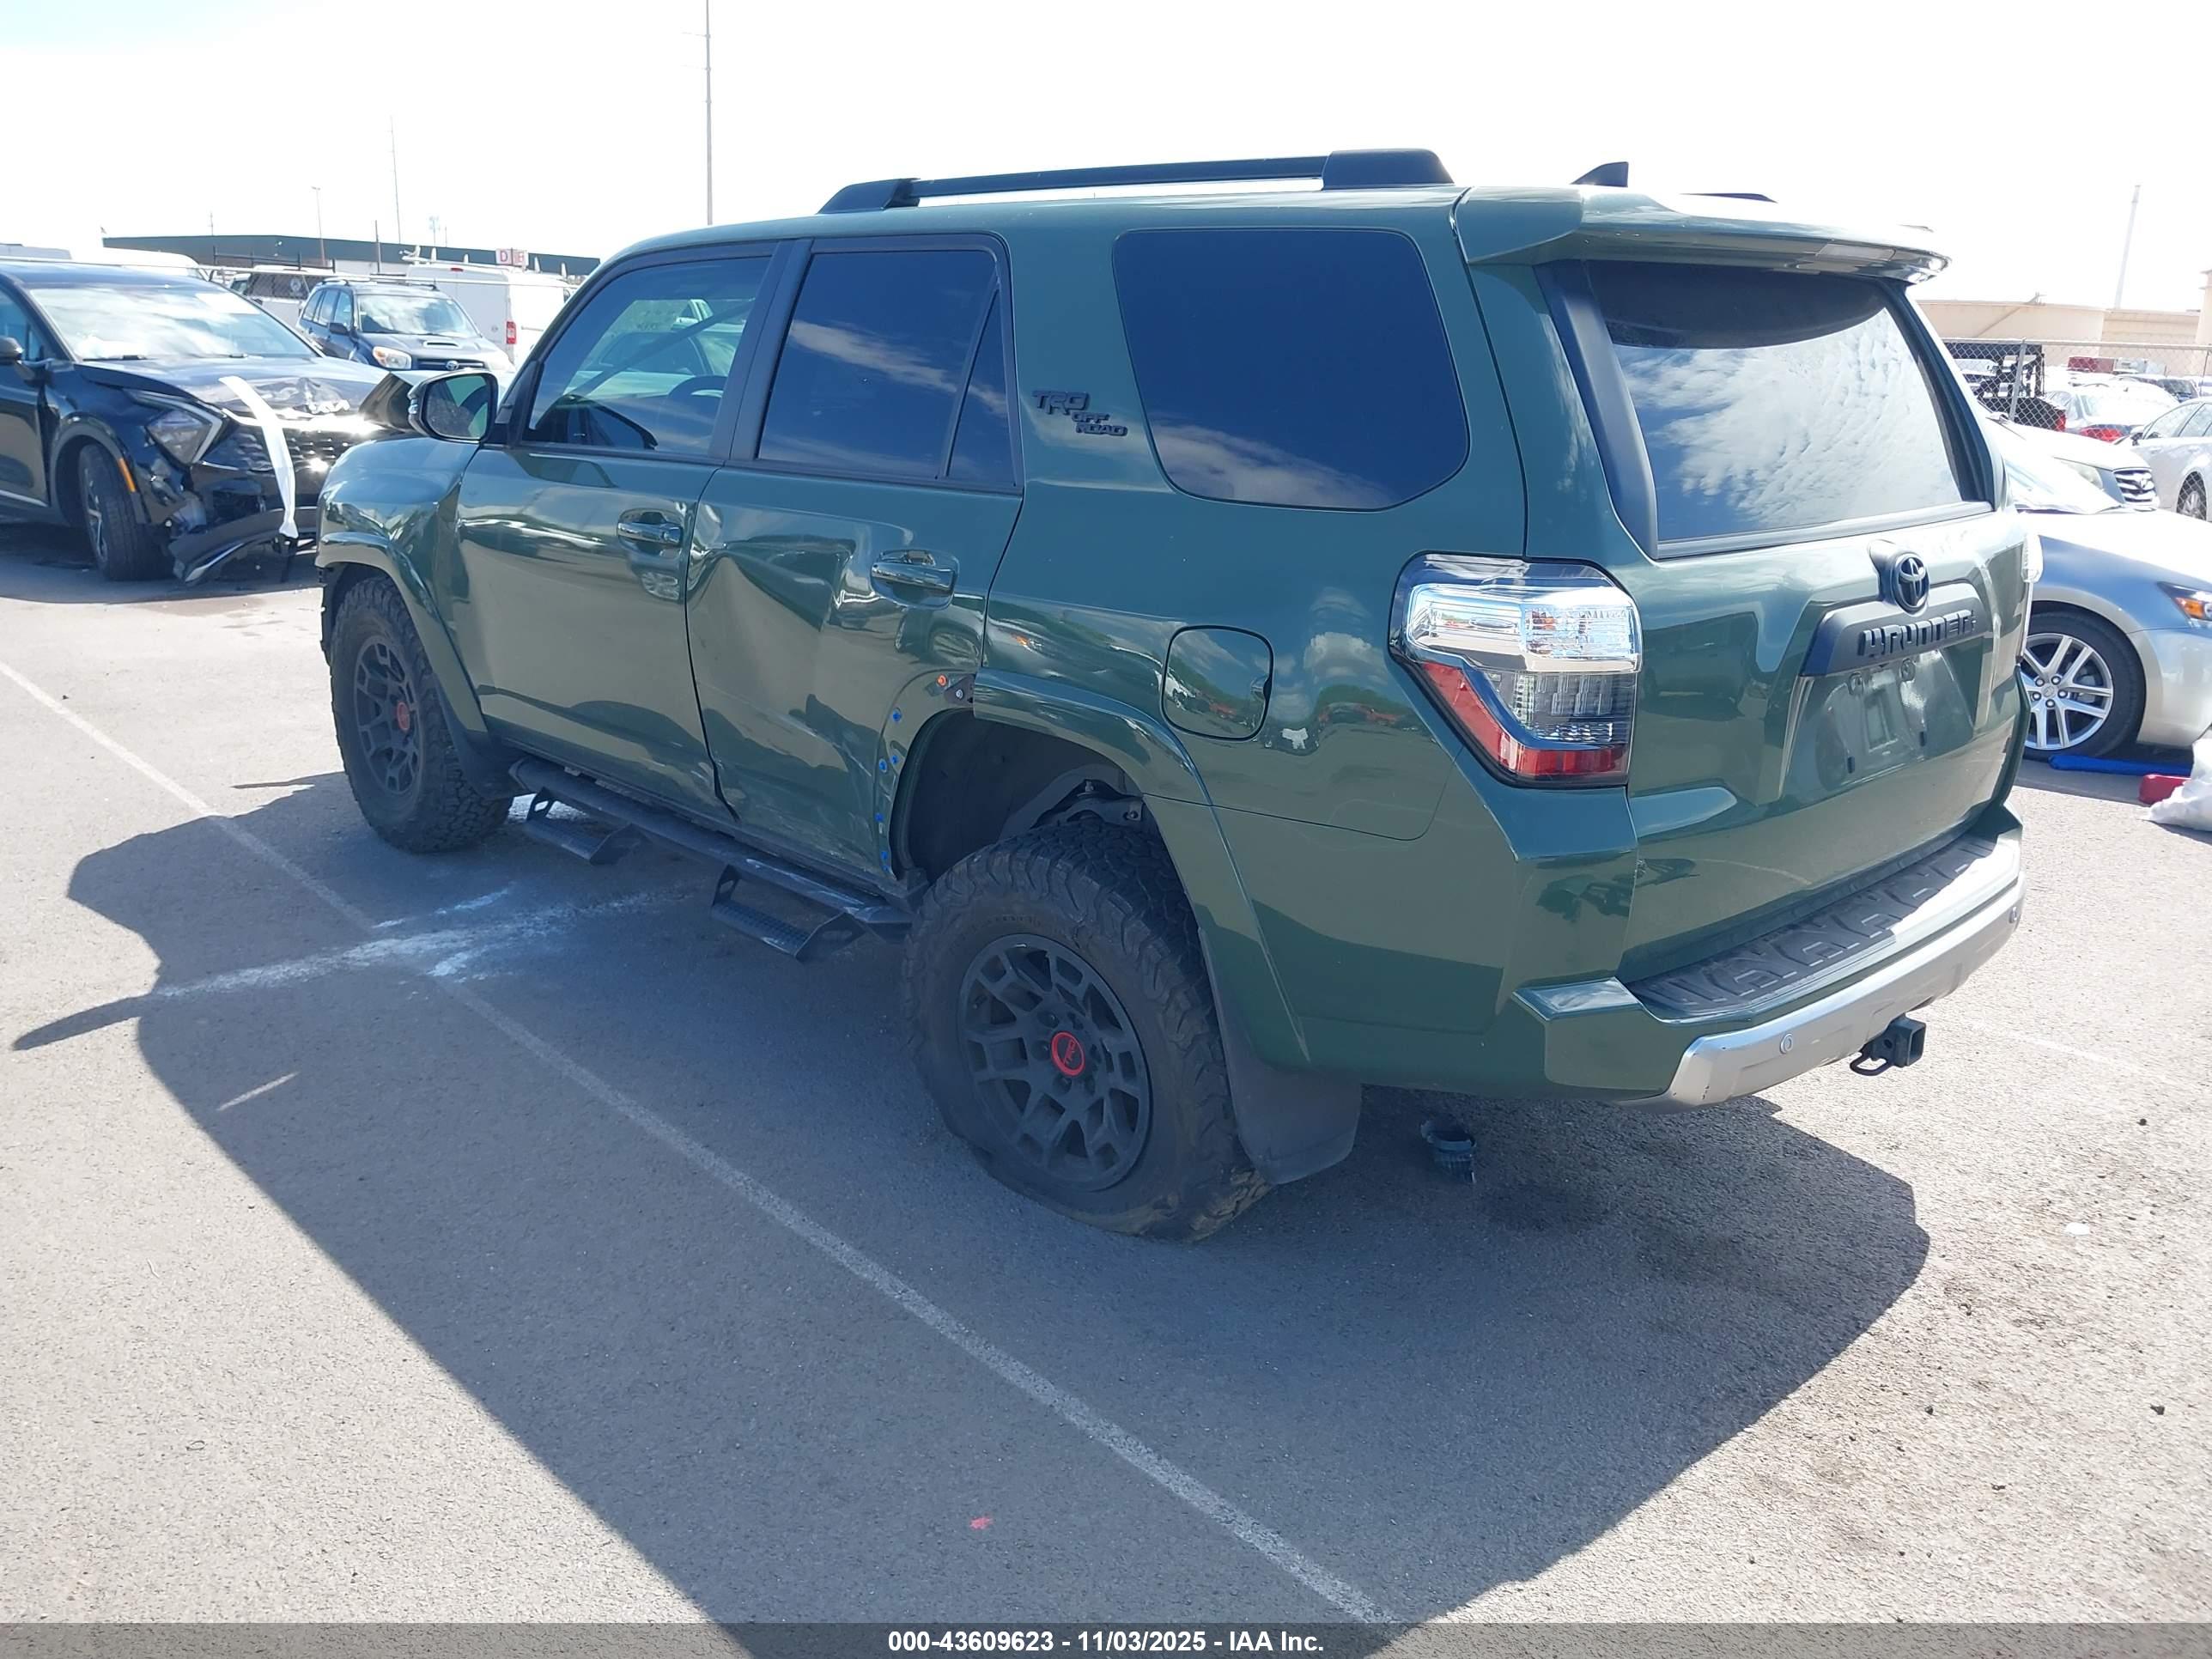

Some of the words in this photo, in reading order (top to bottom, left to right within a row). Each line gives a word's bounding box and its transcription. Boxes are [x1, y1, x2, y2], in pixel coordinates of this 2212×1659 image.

[1032, 391, 1090, 415] TRD
[1072, 412, 1111, 423] OFF
[1076, 422, 1128, 436] ROAD
[1857, 609, 1978, 659] 4RUNNER
